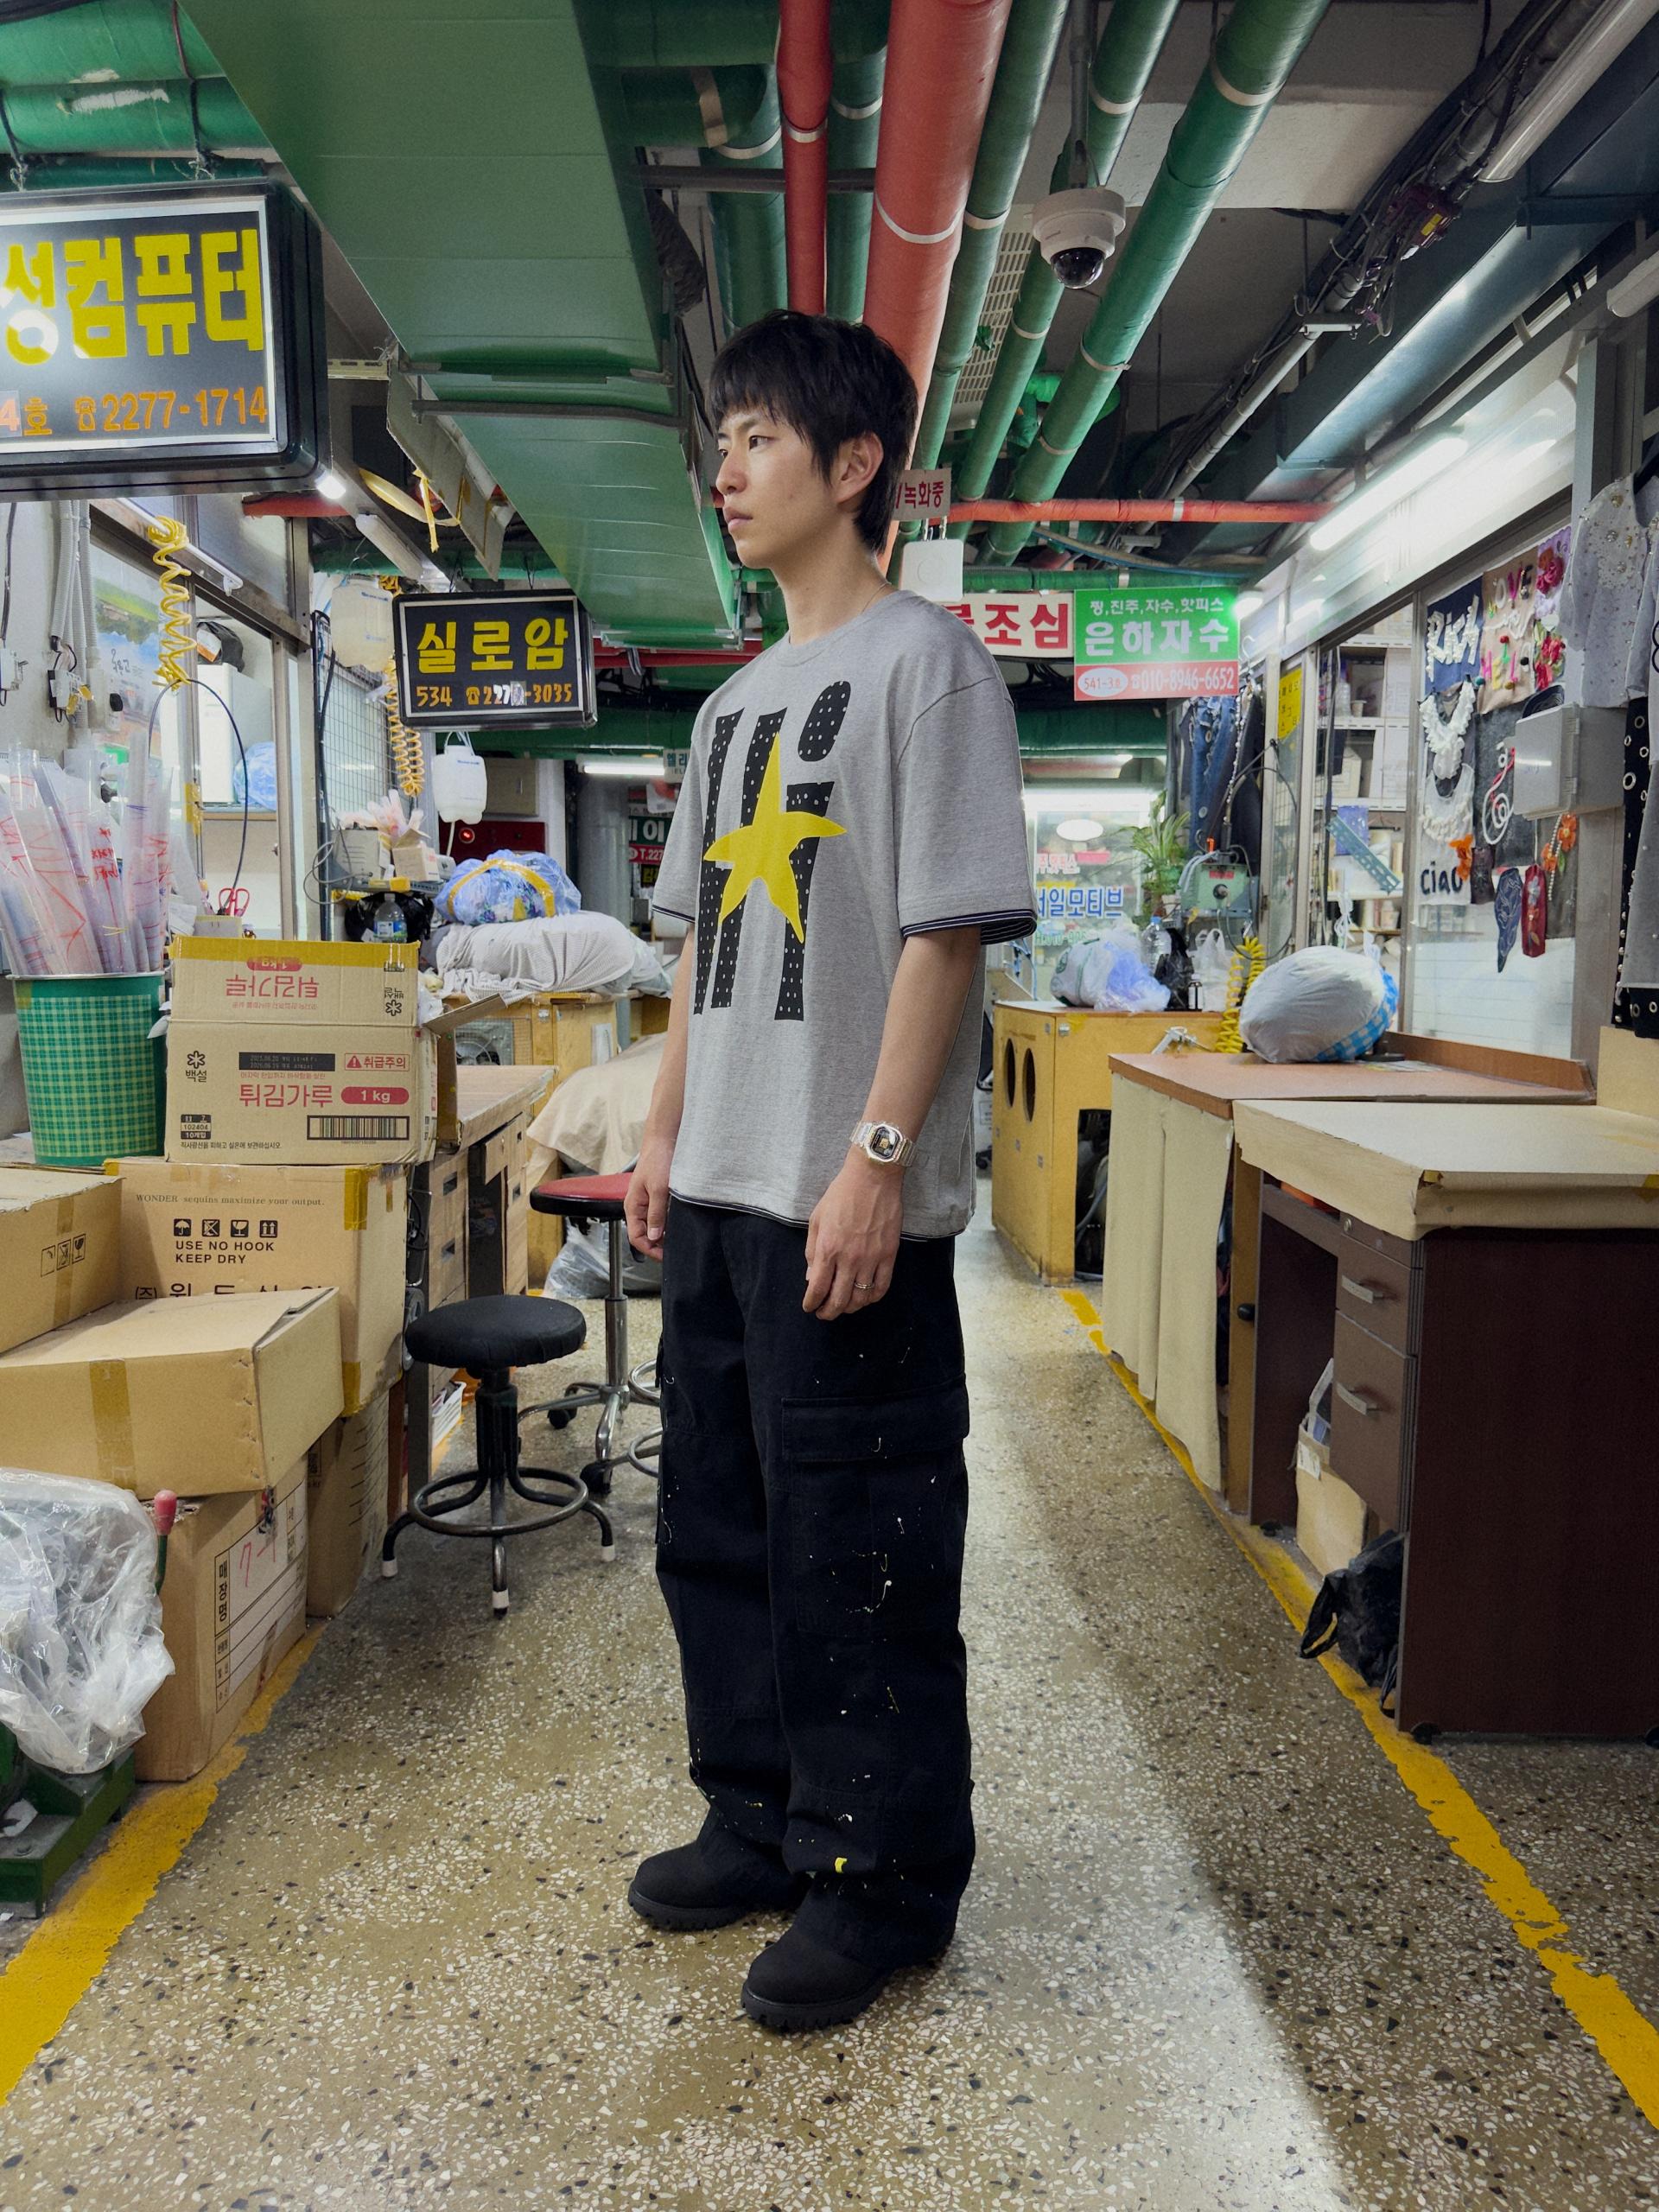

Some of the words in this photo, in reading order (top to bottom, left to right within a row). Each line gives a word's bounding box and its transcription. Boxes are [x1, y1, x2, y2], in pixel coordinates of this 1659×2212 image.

[3, 229, 264, 365] 성컴퓨터
[103, 387, 268, 431] 2277-1714
[416, 617, 569, 673] 실로암
[1084, 618, 1230, 656] 은하자수
[1141, 667, 1235, 692] 010-8946-6652
[416, 685, 453, 707] 534
[226, 974, 320, 998] 튀김가루
[364, 1056, 406, 1070] 취급주의
[185, 1070, 207, 1083] 백설
[239, 1084, 334, 1108] 튀김가루
[361, 1090, 368, 1102] 1
[372, 1090, 391, 1103] kg
[136, 1194, 178, 1204] WONDER
[183, 1195, 219, 1206] sequins
[220, 1197, 266, 1205] maximize
[268, 1198, 289, 1207] your
[175, 1240, 204, 1251] USE
[209, 1241, 229, 1252] NO
[234, 1242, 275, 1252] HOOK
[175, 1254, 213, 1264] KEEP
[218, 1254, 247, 1265] DRY
